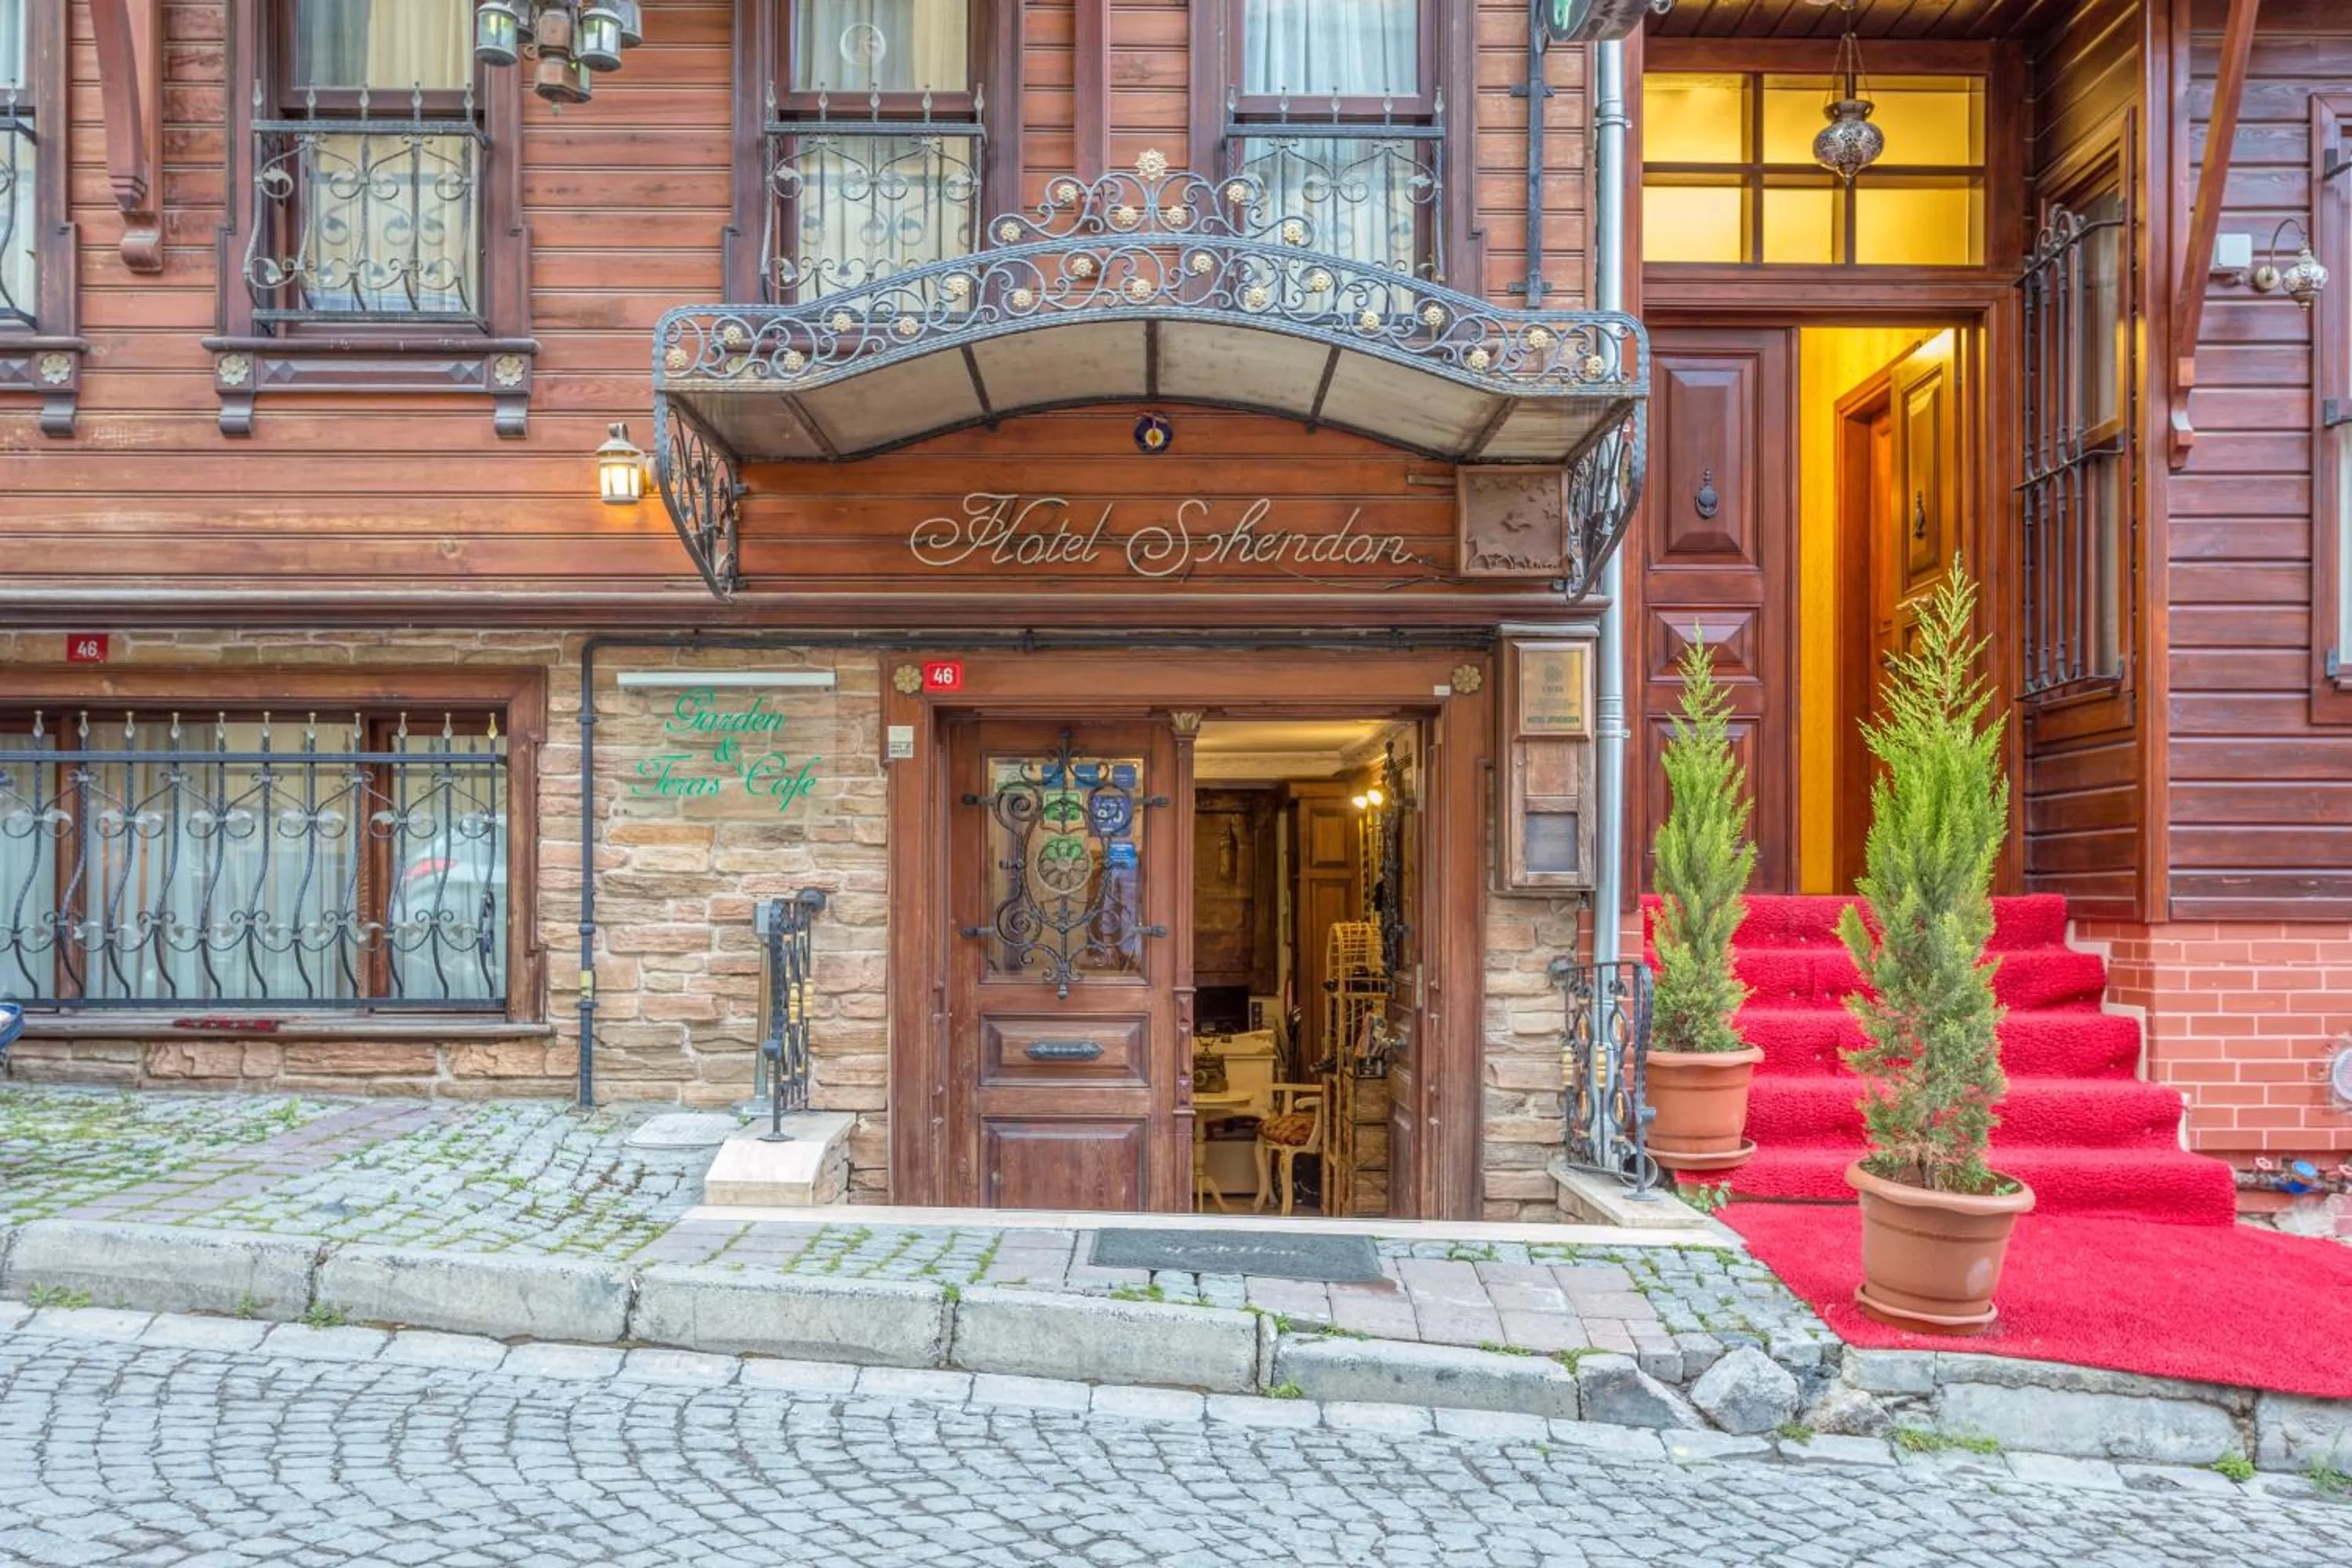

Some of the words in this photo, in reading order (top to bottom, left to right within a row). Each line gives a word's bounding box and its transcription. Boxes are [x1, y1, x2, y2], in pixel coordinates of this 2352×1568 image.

[910, 492, 1113, 565] Hotel
[77, 640, 98, 658] 46
[665, 686, 787, 734] Garden
[713, 735, 741, 764] &
[736, 751, 824, 813] Cafe
